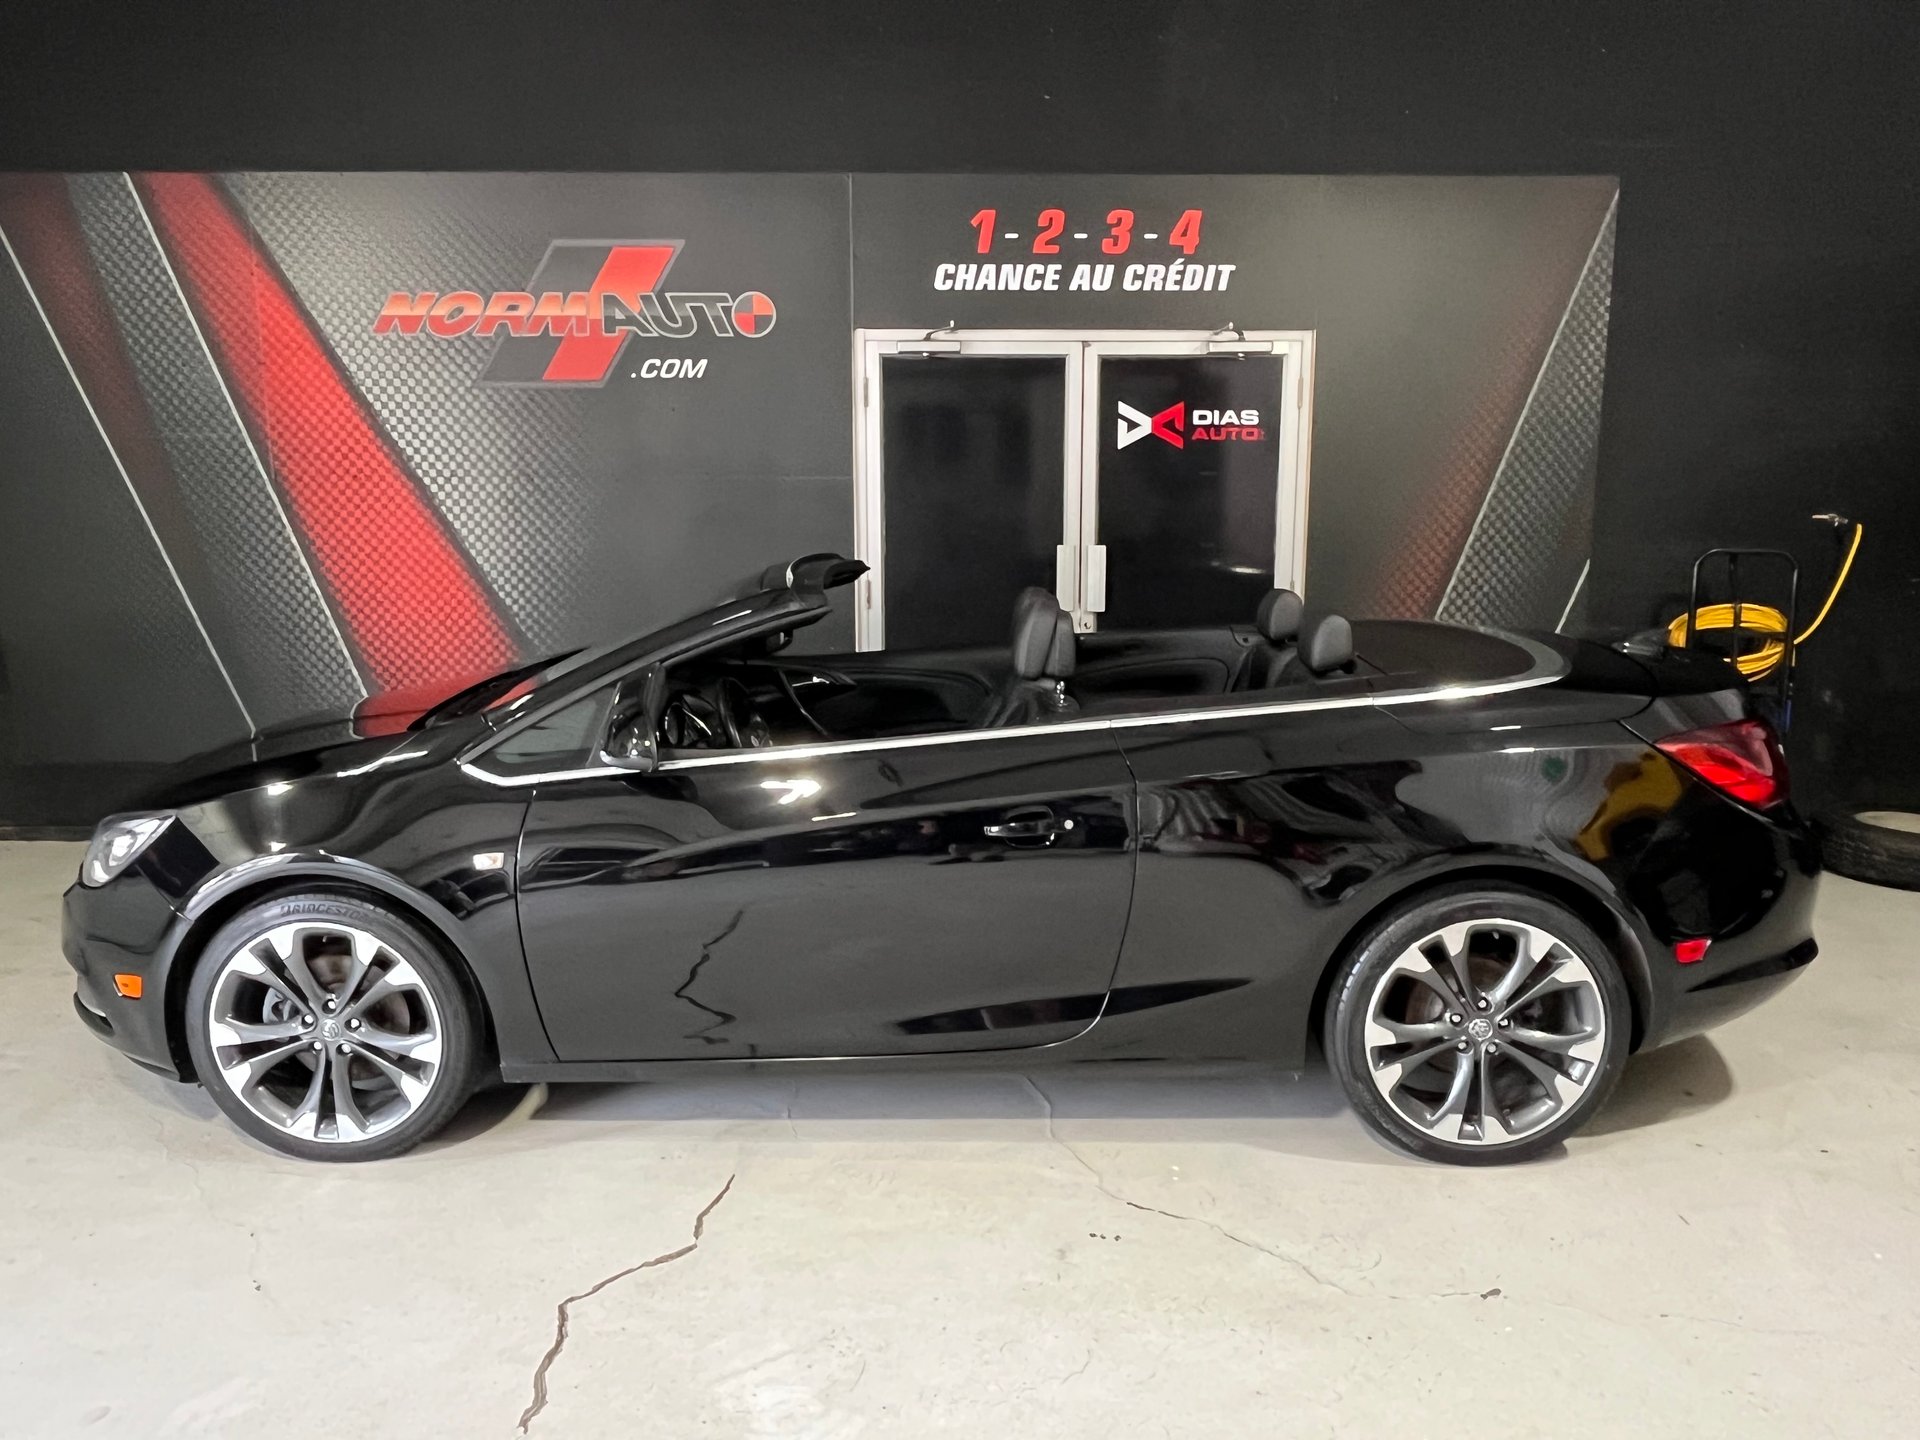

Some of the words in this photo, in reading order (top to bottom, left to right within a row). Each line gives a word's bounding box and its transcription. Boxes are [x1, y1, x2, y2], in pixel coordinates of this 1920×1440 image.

[933, 263, 1062, 291] CHANCE
[1068, 264, 1114, 291] AU
[1122, 258, 1236, 292] CRÉDIT
[630, 358, 708, 379] .COM
[1192, 409, 1260, 426] DIAS
[1191, 427, 1259, 441] AUTO
